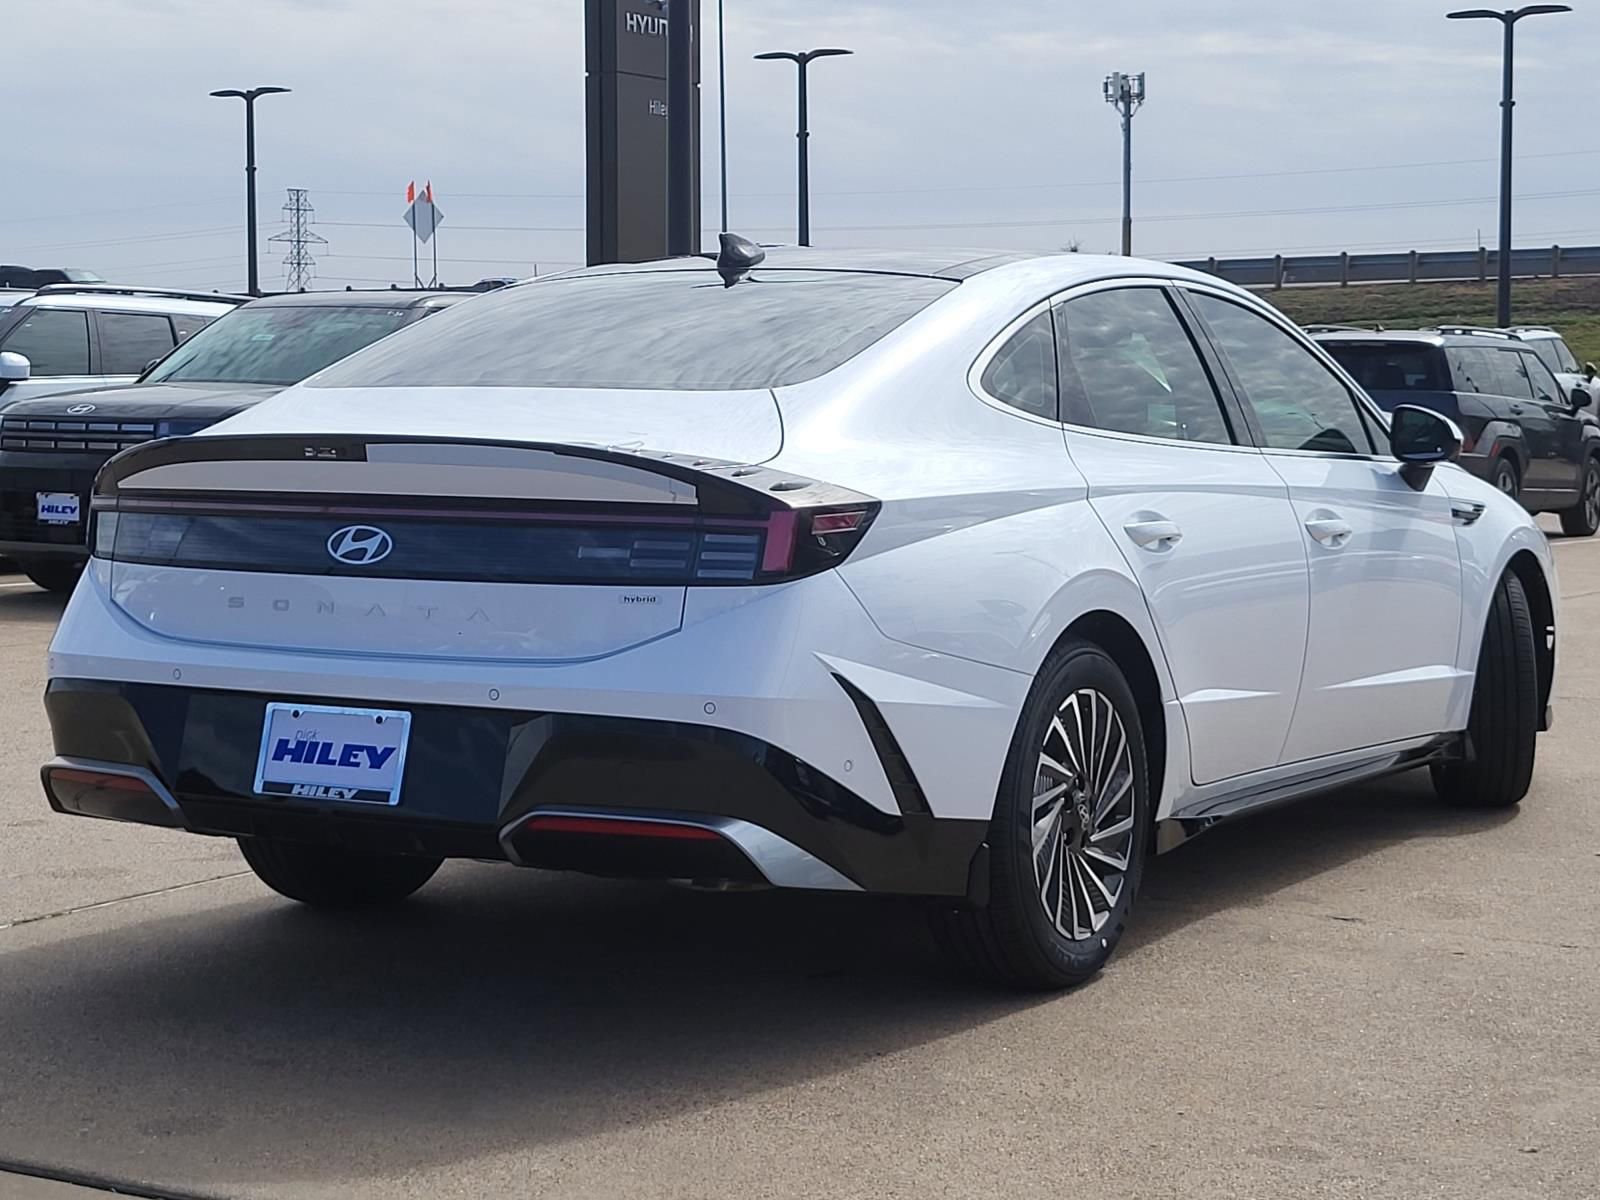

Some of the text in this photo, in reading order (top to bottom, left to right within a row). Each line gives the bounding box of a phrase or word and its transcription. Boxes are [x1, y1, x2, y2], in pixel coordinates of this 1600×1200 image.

[41, 504, 78, 514] HILEY
[623, 595, 657, 604] hybrid
[227, 595, 491, 622] SONATA
[271, 738, 397, 770] HILEY
[291, 783, 360, 800] HILEY
